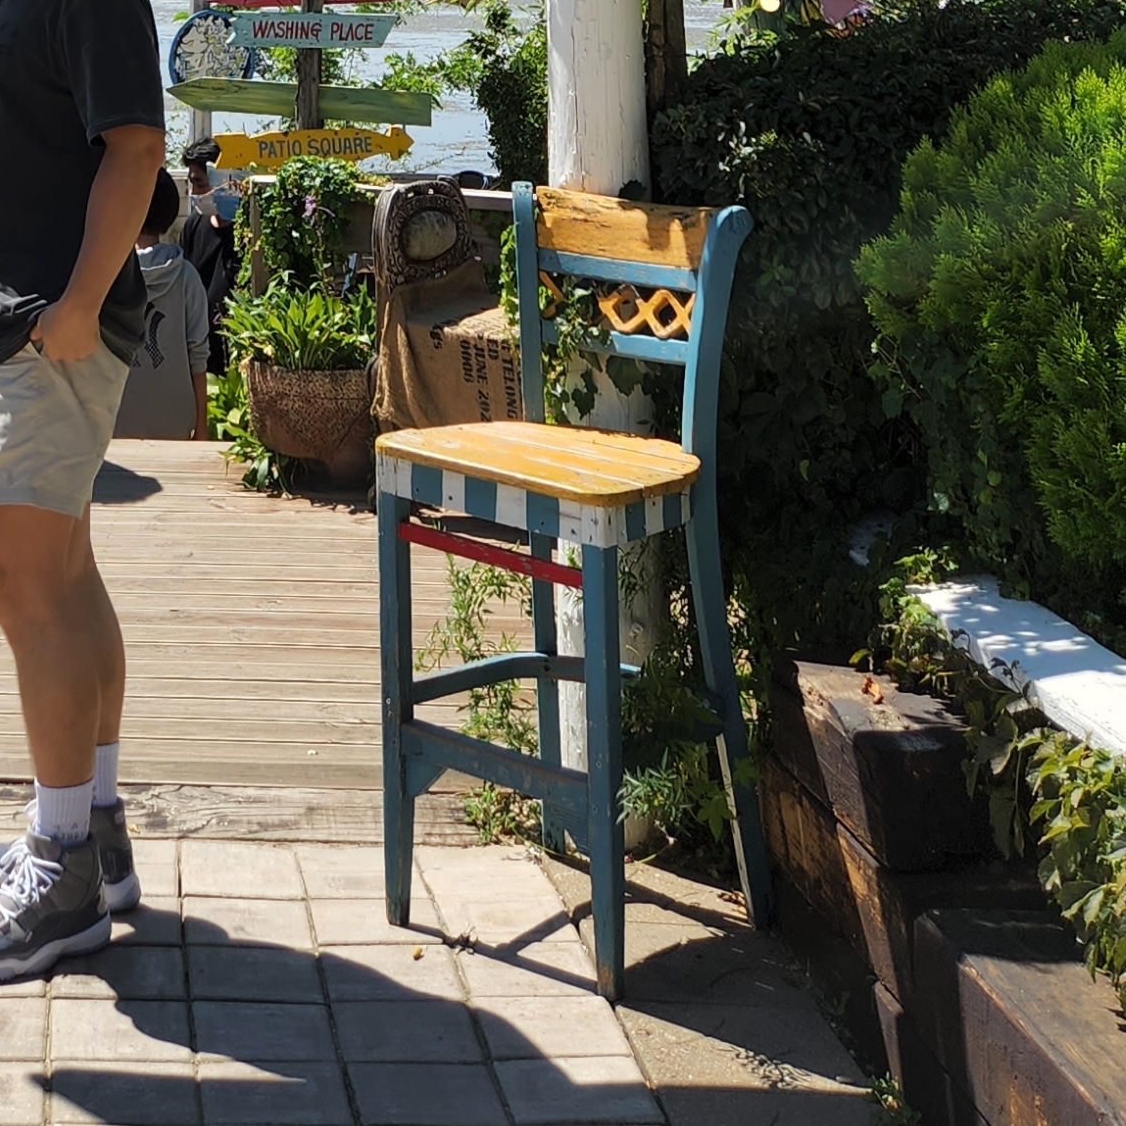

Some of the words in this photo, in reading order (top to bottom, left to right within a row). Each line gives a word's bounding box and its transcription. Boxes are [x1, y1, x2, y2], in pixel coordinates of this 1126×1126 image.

[252, 20, 322, 42] WASHING
[330, 22, 374, 41] PLACE
[259, 140, 302, 158] PATIO
[307, 137, 372, 156] SQUARE
[474, 344, 488, 385] JUNE
